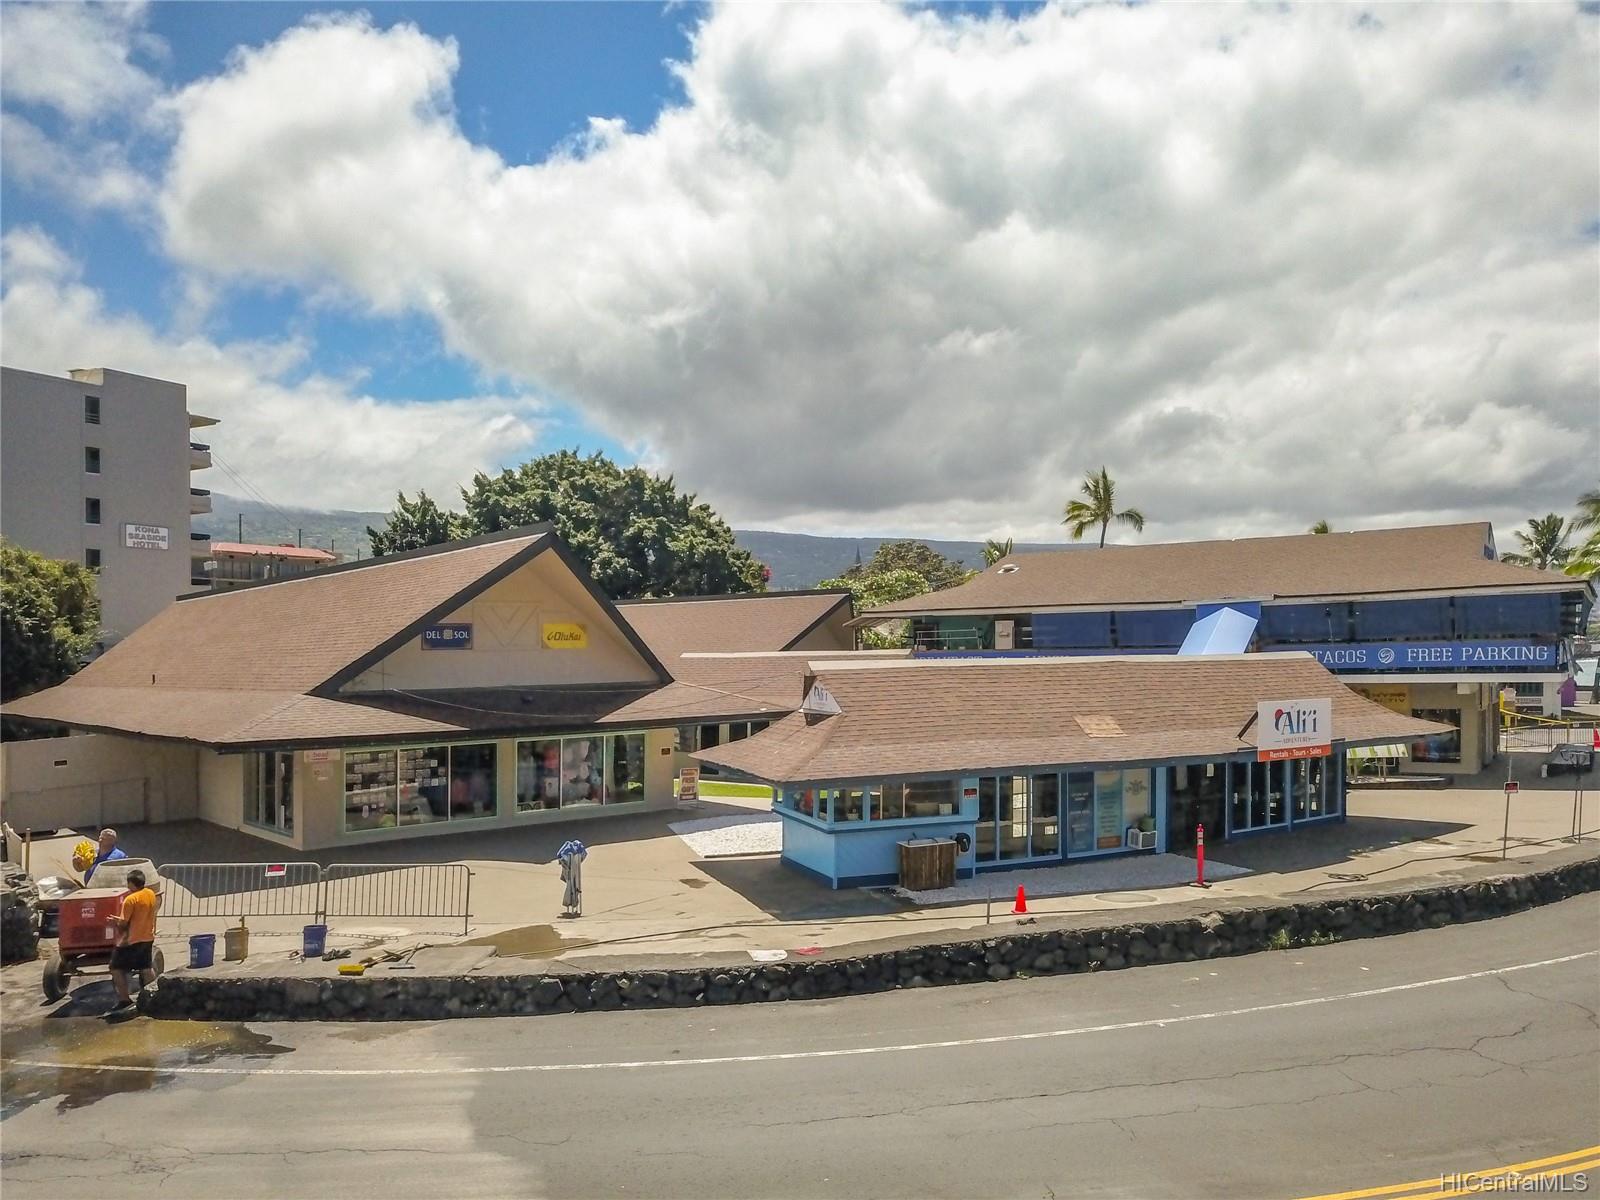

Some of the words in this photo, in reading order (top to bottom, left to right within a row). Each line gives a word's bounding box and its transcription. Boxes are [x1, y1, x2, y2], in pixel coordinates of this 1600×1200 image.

[134, 526, 161, 534] KONA
[127, 532, 167, 542] SEASIDE
[132, 541, 161, 550] HOTEL
[426, 631, 441, 639] DEL
[454, 630, 469, 639] SOL
[1312, 649, 1367, 664] TACOS
[1407, 647, 1453, 662] FREE
[1461, 641, 1549, 661] PARKING
[1269, 750, 1289, 758] Rentals
[1292, 748, 1307, 756] Tours
[1309, 747, 1322, 755] Sales
